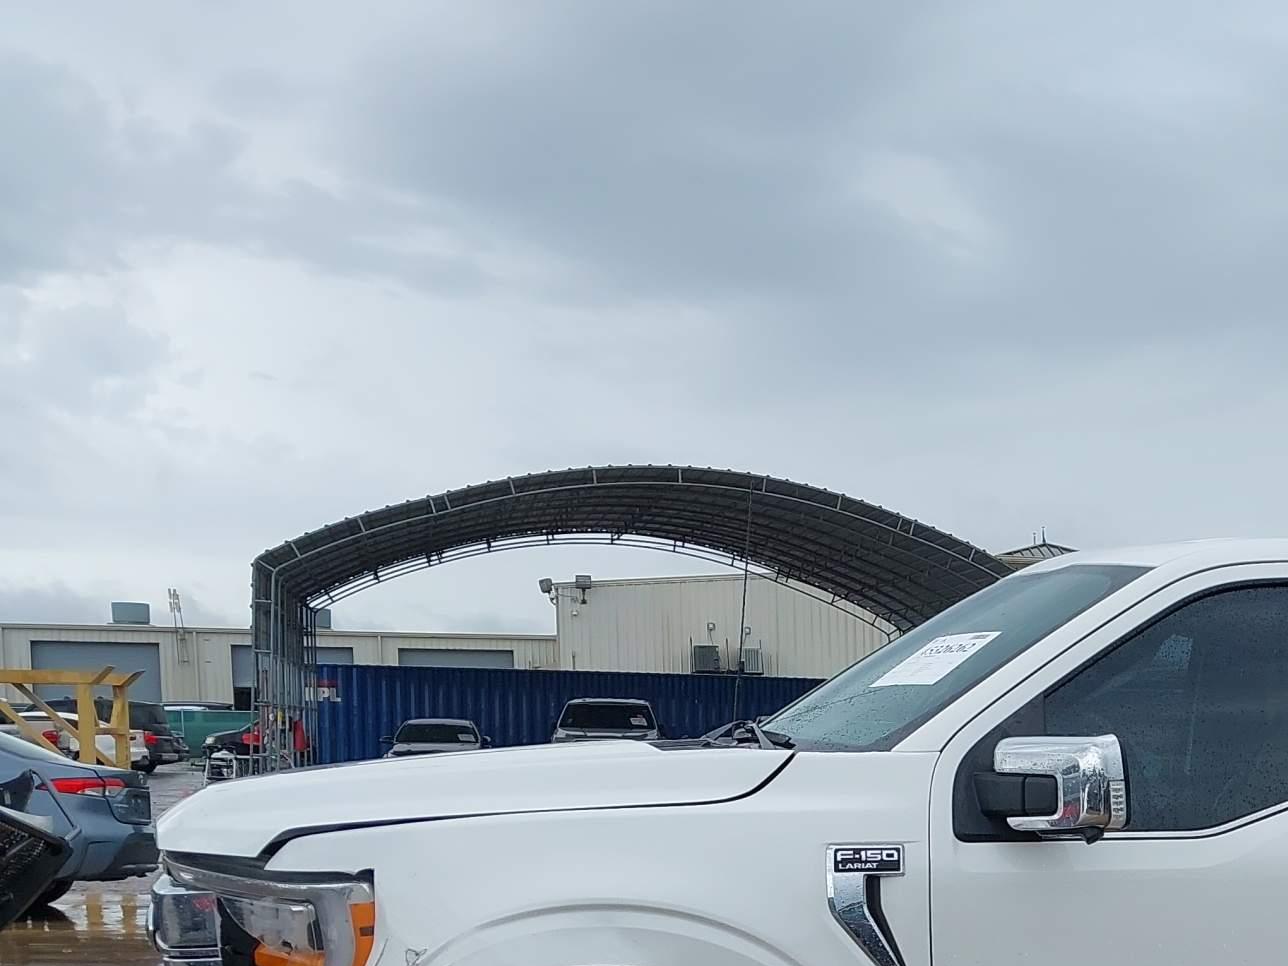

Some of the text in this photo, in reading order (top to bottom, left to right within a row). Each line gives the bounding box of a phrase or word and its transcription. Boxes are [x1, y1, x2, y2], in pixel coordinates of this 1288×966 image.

[304, 686, 342, 702] PL
[836, 849, 899, 861] F-150
[838, 862, 879, 870] LARIAT
